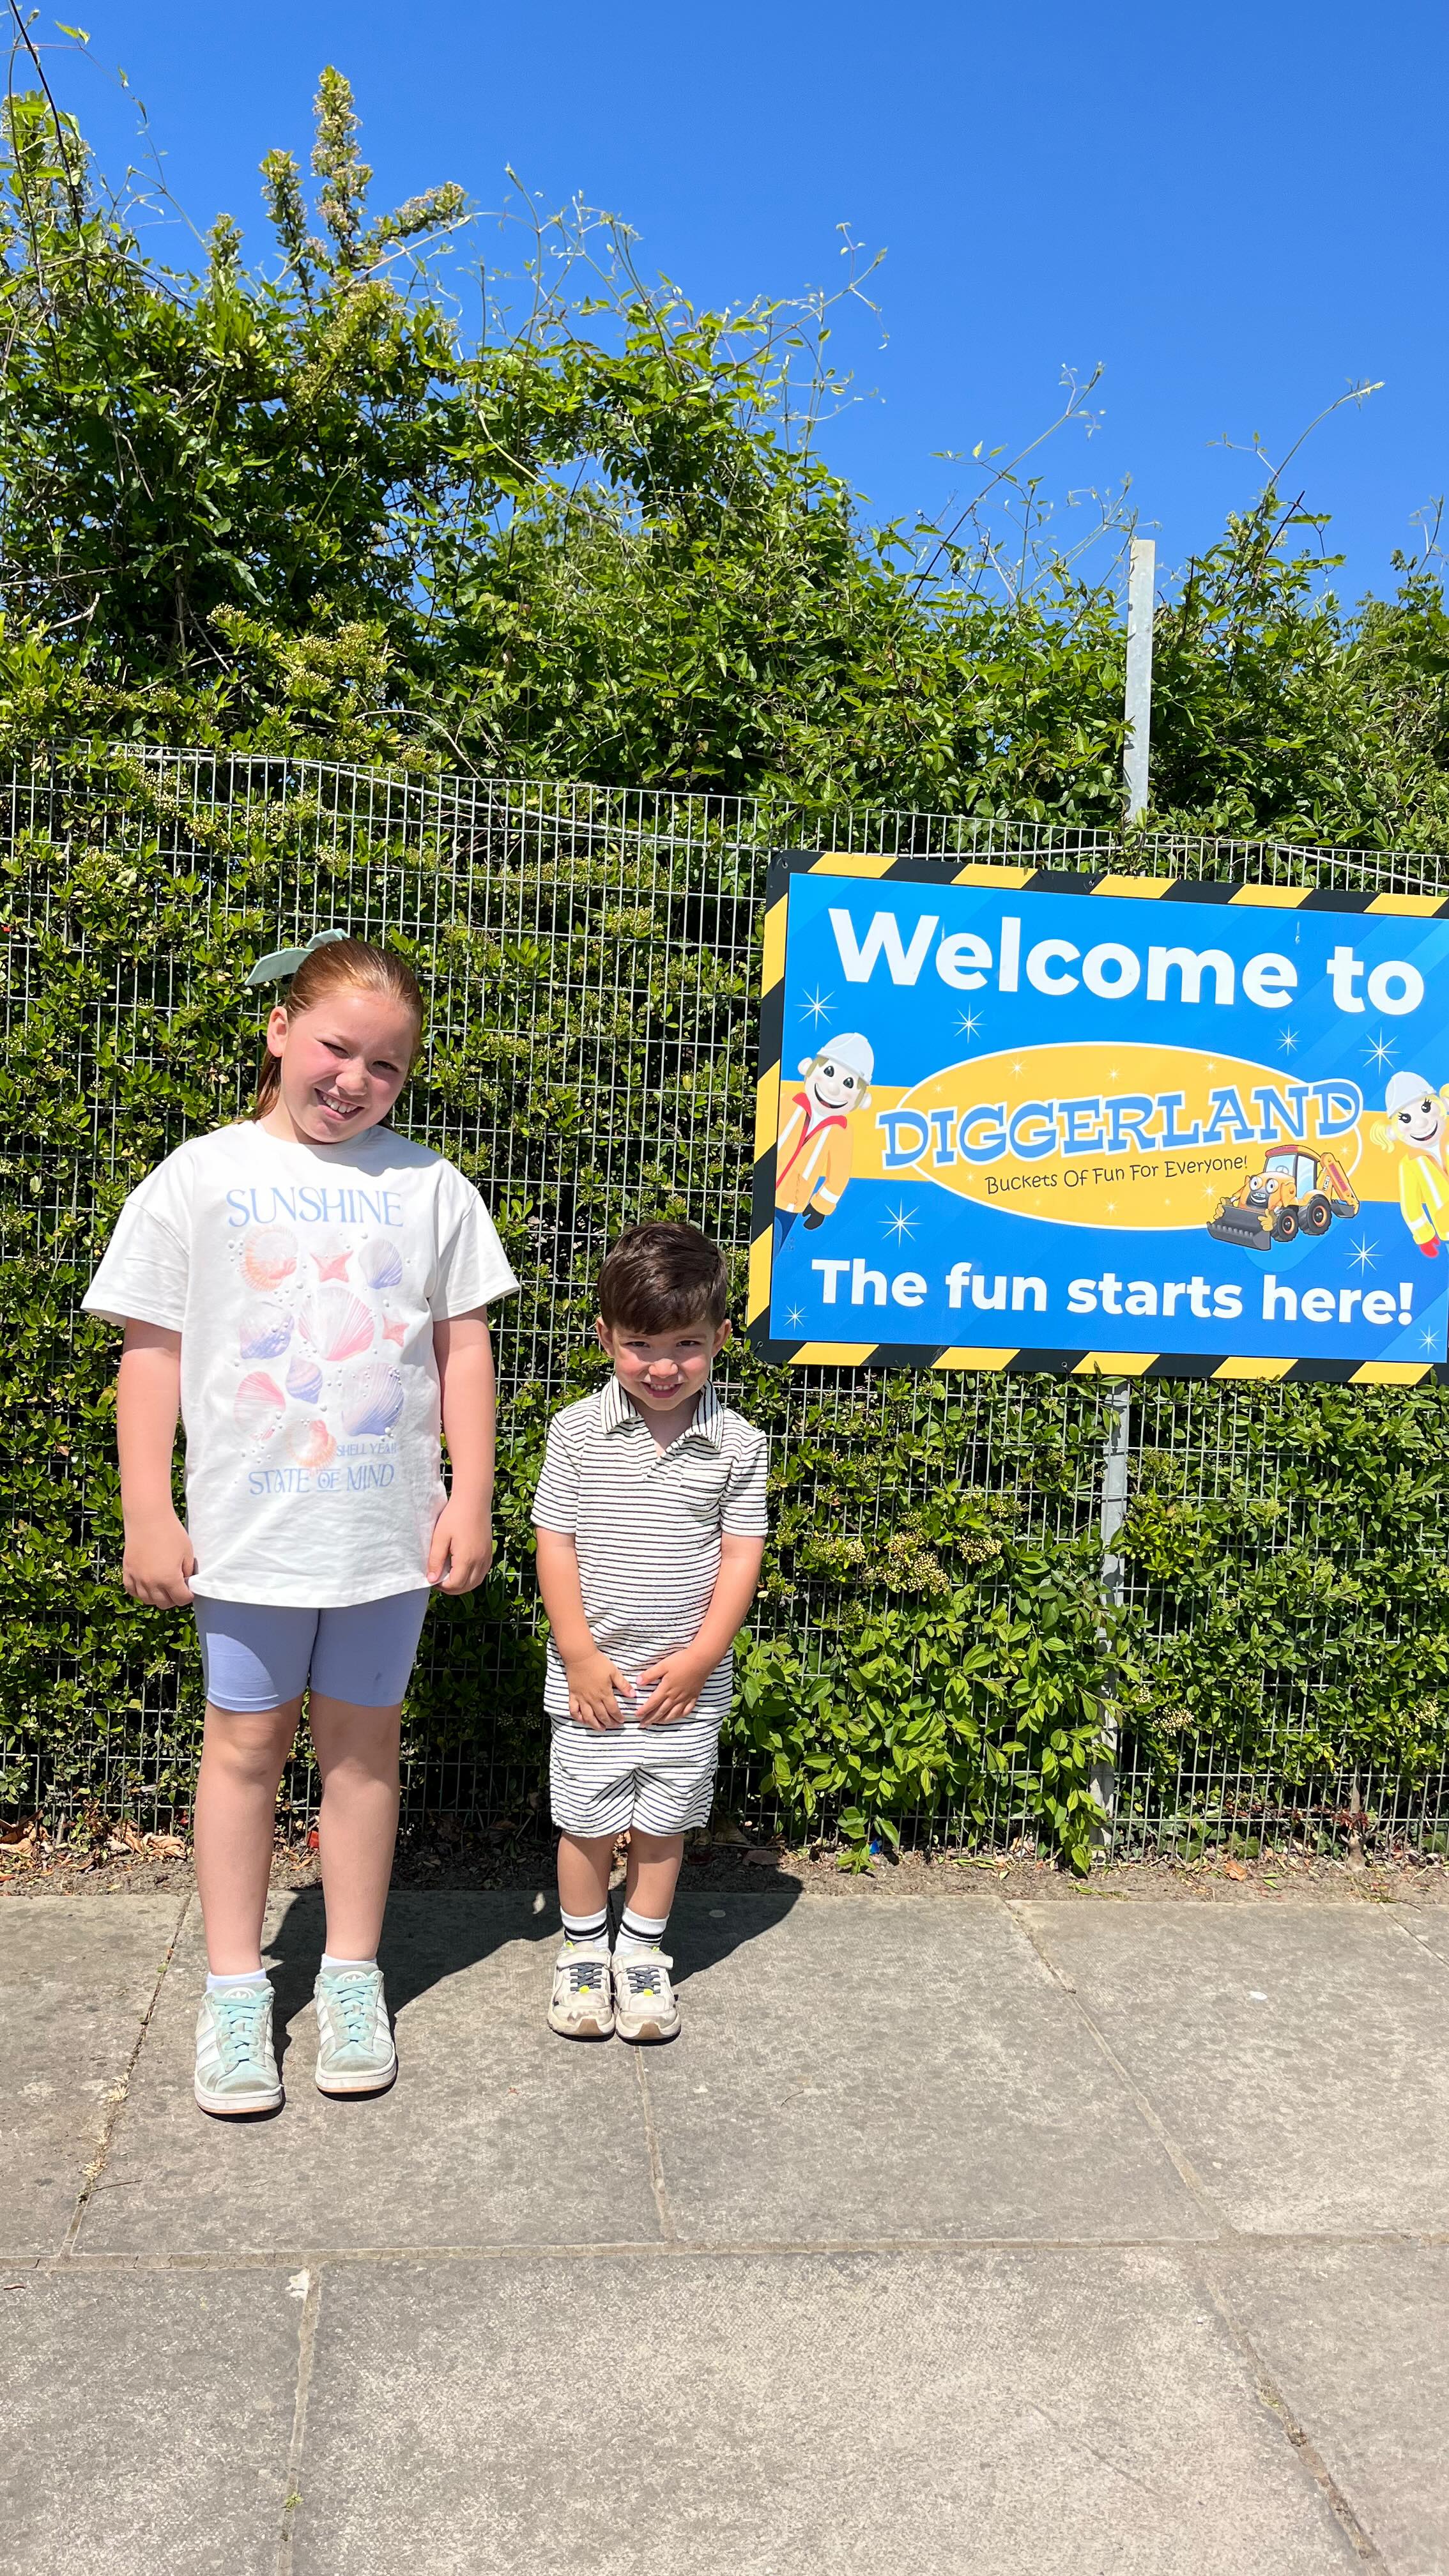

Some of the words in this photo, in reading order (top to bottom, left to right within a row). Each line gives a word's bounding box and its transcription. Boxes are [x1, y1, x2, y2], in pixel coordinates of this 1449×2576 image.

[829, 908, 1298, 1008] Welcome
[1327, 946, 1425, 1015] to
[877, 1080, 1362, 1169] DIGGERLAND
[985, 1174, 1058, 1195] Buckets
[1064, 1169, 1089, 1188] Of
[1092, 1167, 1124, 1184] Fun
[1130, 1164, 1159, 1181] For
[1164, 1155, 1248, 1178] Everyone!
[226, 1186, 403, 1227] SUNSHINE
[811, 1259, 926, 1307] The
[946, 1262, 1047, 1312] fun
[1067, 1273, 1243, 1319] starts
[1262, 1274, 1413, 1326] here!
[337, 1443, 367, 1456] SHELL
[370, 1443, 397, 1454] YEAH
[248, 1469, 310, 1495] STATE
[317, 1471, 341, 1489] OF
[346, 1464, 394, 1491] MIND
